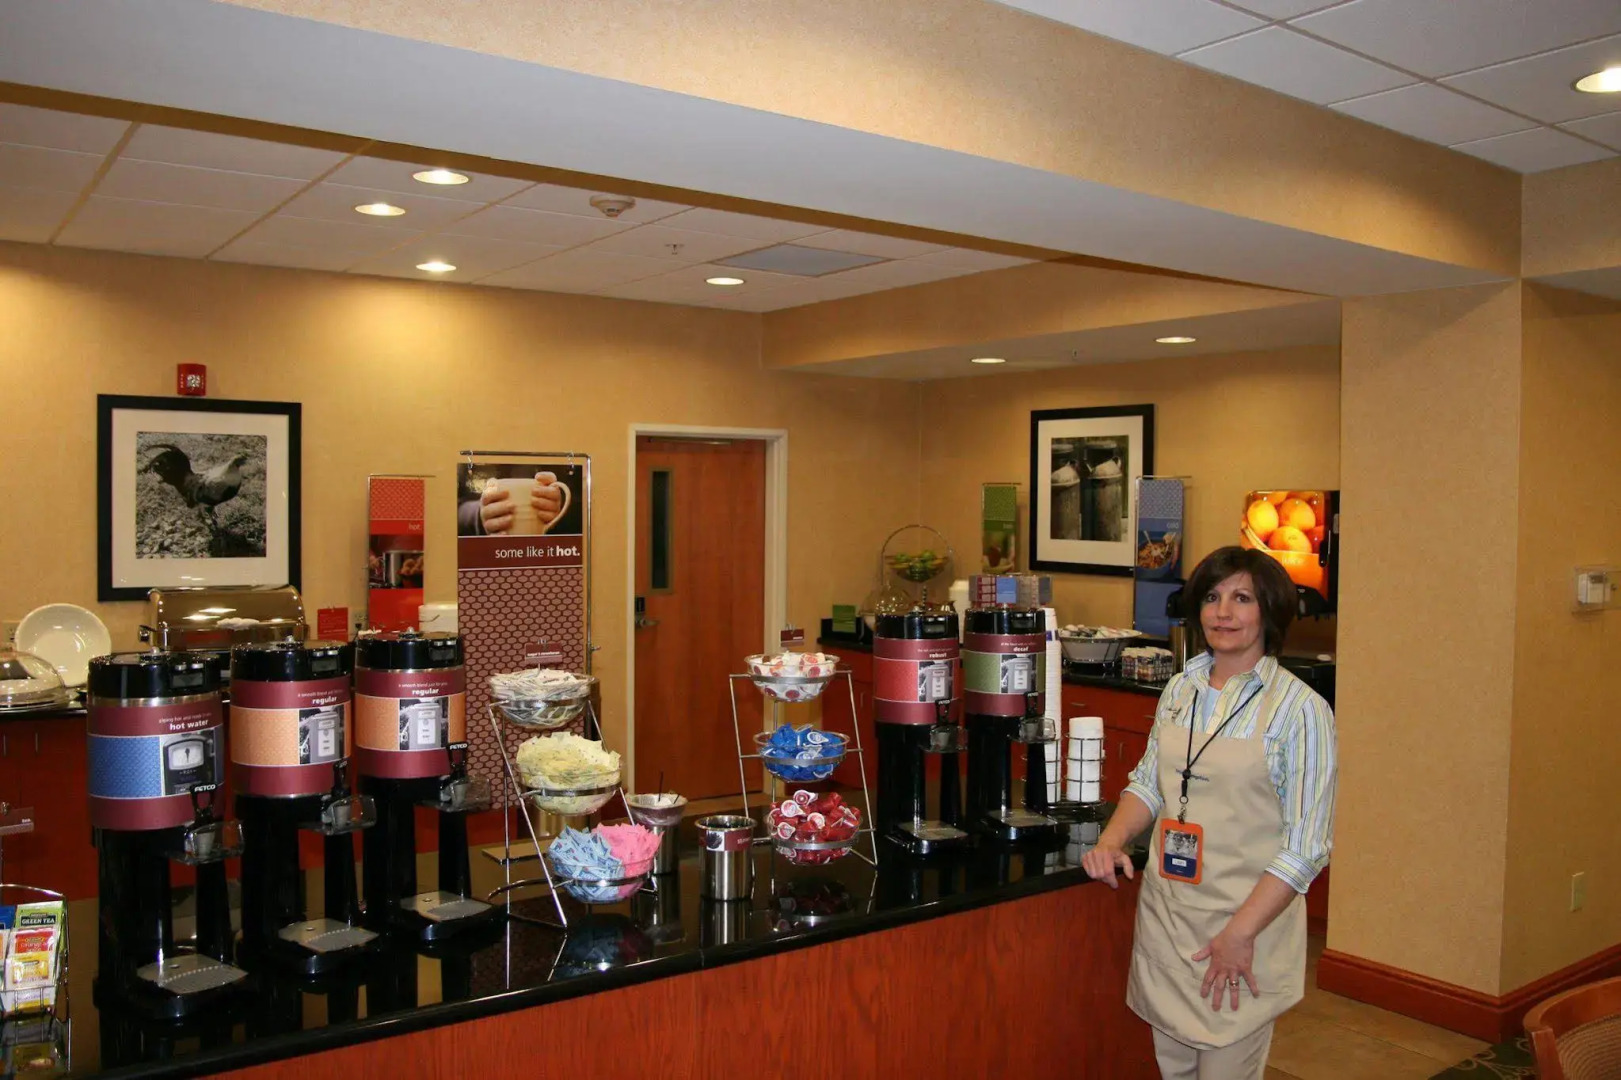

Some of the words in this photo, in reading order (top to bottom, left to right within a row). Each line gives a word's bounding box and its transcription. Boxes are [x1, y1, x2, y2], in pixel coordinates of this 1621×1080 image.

[495, 549, 524, 558] some
[527, 546, 544, 557] like
[547, 546, 555, 557] it
[556, 545, 581, 557] hot.
[412, 688, 439, 696] regular
[312, 696, 337, 705] regular
[170, 722, 185, 730] hot
[187, 719, 209, 728] water
